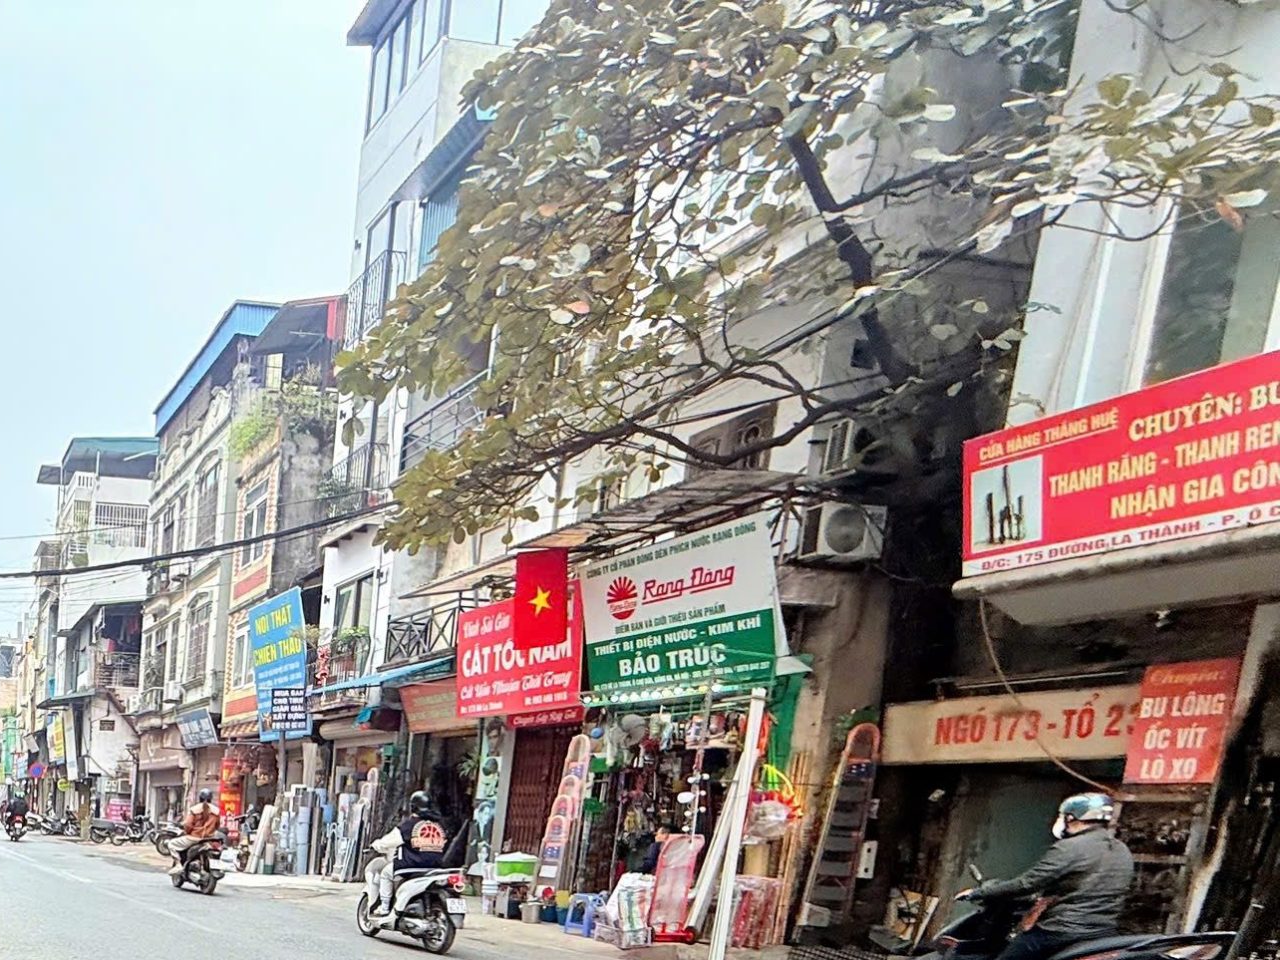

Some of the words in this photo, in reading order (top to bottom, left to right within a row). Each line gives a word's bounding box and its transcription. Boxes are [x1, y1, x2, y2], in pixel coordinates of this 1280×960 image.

[1128, 391, 1243, 442] CHUYÊN:
[979, 440, 1004, 461] CỬA
[1006, 431, 1042, 454] HÀNG
[1048, 464, 1104, 499] THANH
[1106, 451, 1158, 485] RĂNG
[1174, 430, 1240, 469] THANH
[1109, 483, 1176, 520] NHẬN
[1182, 473, 1225, 505] GIA
[981, 558, 1011, 571] Đ/C:
[1017, 550, 1044, 565] 175
[1112, 533, 1133, 547] LA
[1138, 519, 1201, 541] THÀNH
[602, 564, 610, 575] TY
[594, 640, 621, 657] THIẾT
[622, 640, 635, 654] BỊ
[636, 635, 662, 651] ĐIỆN
[664, 628, 697, 645] NƯỚC
[708, 621, 734, 637] KIM
[737, 613, 761, 631] KHÍ
[461, 643, 491, 678] CẮT
[619, 651, 661, 678] BẢO
[665, 641, 728, 671] TRÚC
[993, 709, 1043, 742] 173
[1063, 692, 1100, 740] TỔ
[1139, 696, 1169, 719] BU
[1170, 690, 1227, 717] LÔNG
[1143, 720, 1171, 751] ỐC
[1175, 722, 1208, 750] VÍT
[1139, 753, 1164, 780] LÒ
[1168, 757, 1198, 781] XO
